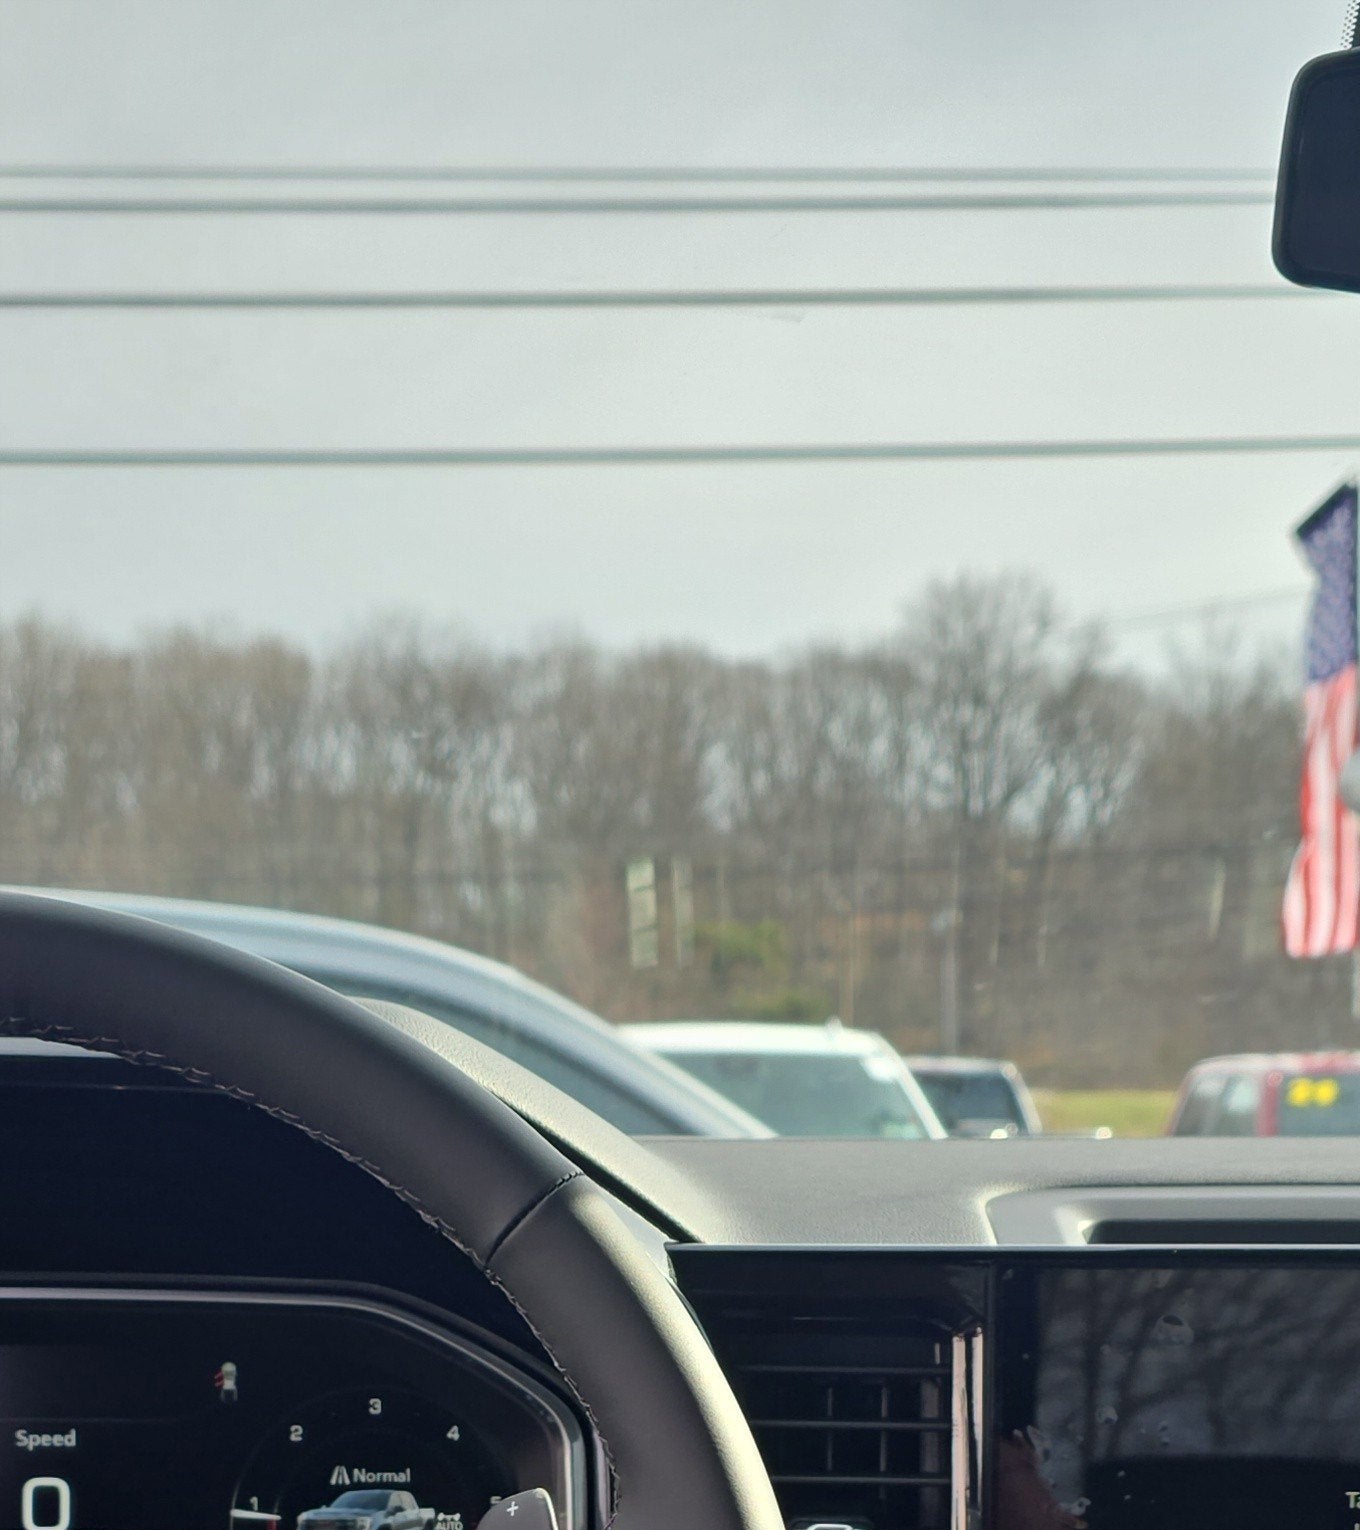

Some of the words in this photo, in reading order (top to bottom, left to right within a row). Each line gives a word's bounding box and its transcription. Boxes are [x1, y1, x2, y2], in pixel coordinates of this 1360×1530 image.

[369, 1398, 382, 1415] 3
[14, 1428, 76, 1451] Speed
[290, 1425, 303, 1442] 2
[446, 1425, 460, 1441] 4
[353, 1467, 411, 1484] Normal
[22, 1476, 71, 1530] 0
[249, 1496, 258, 1510] 1
